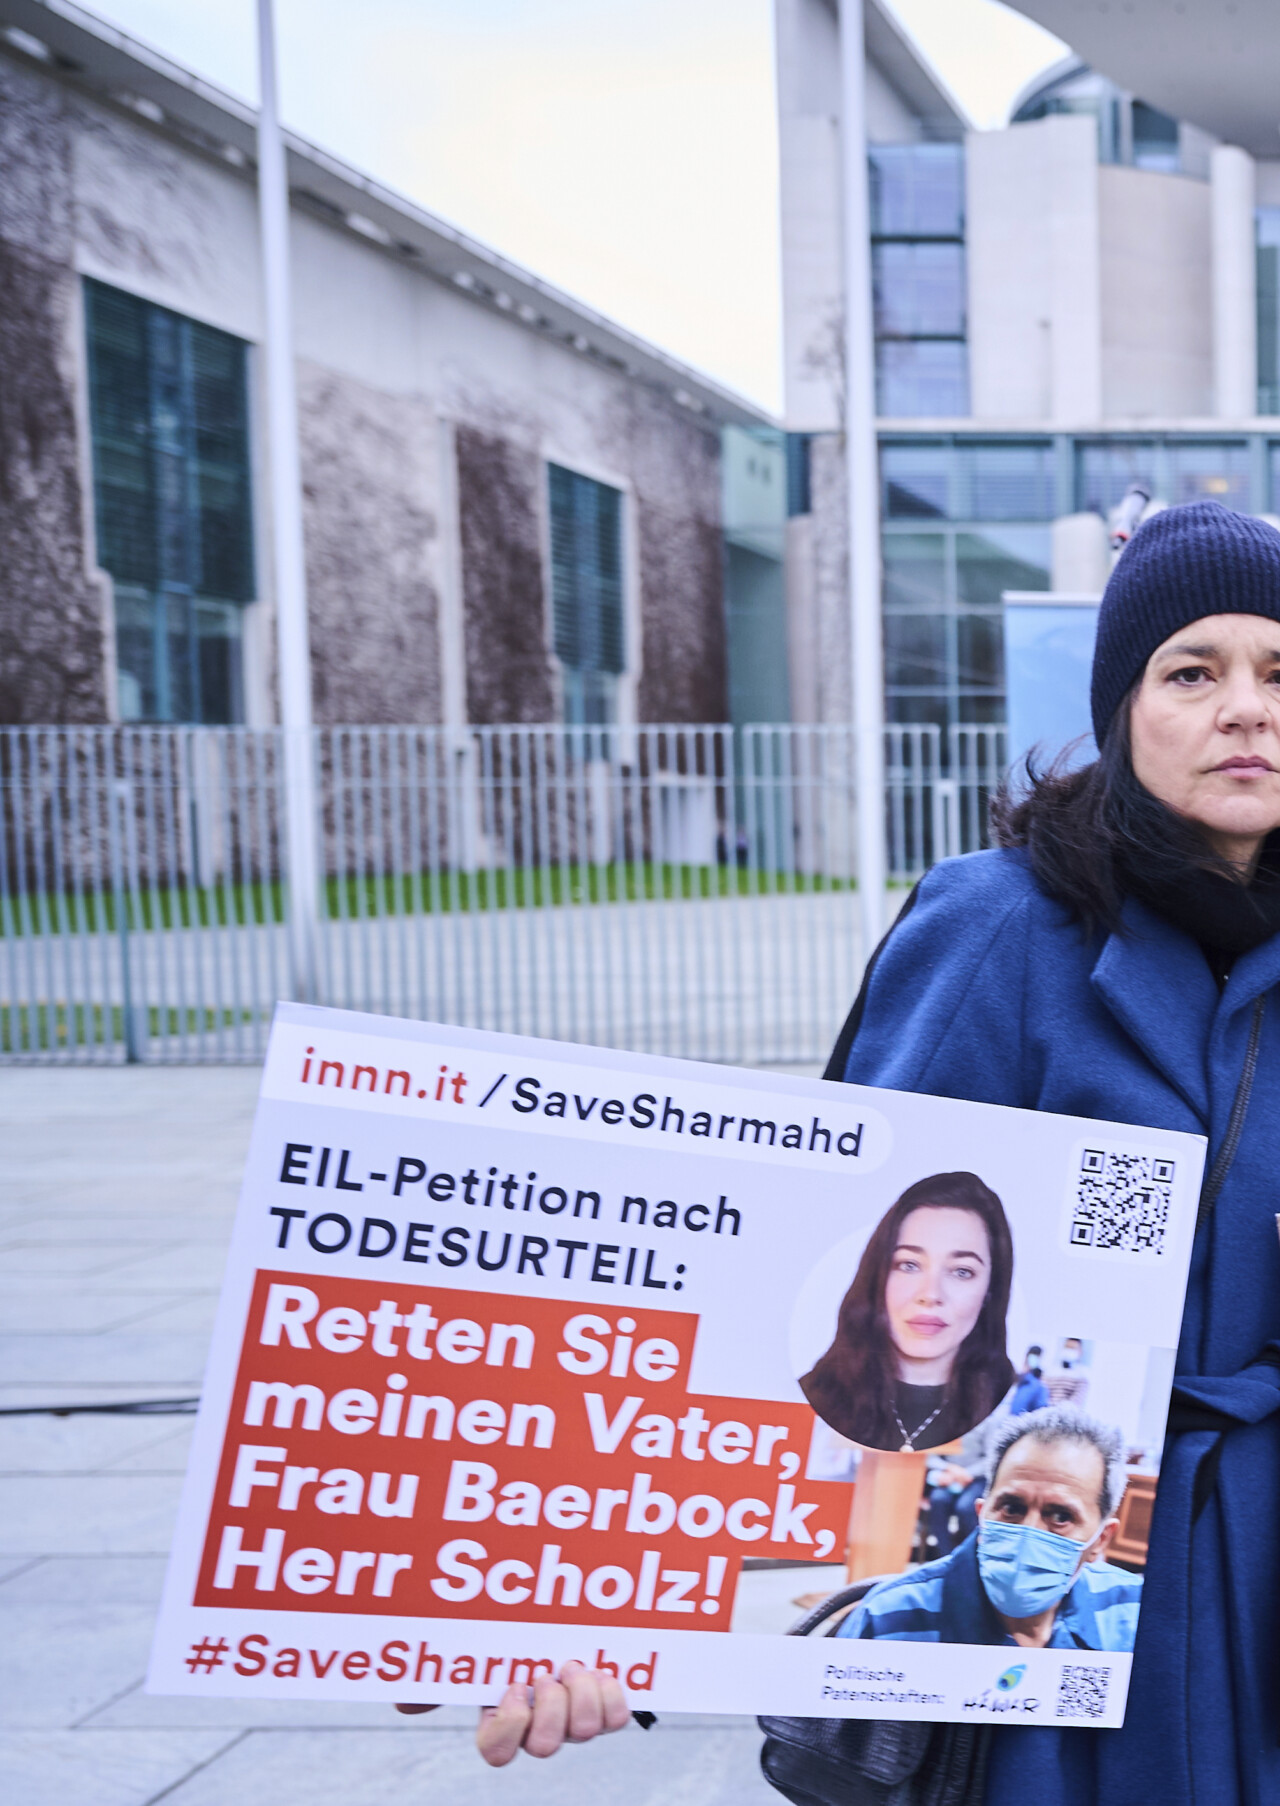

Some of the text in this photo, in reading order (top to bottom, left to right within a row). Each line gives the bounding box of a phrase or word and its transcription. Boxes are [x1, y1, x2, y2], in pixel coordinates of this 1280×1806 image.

[280, 1143, 742, 1236] EIL-Petition nach
[270, 1207, 688, 1291] TODESURTEIL:
[260, 1284, 680, 1381] Retten Sie
[243, 1374, 800, 1479] meinen Vater,
[229, 1445, 836, 1557] Frau Baerbock,
[213, 1527, 729, 1615] Herr Scholz!
[185, 1633, 658, 1691] #SaveSharmhd
[820, 1685, 946, 1703] Patenschaften:
[824, 1664, 906, 1681] Politische
